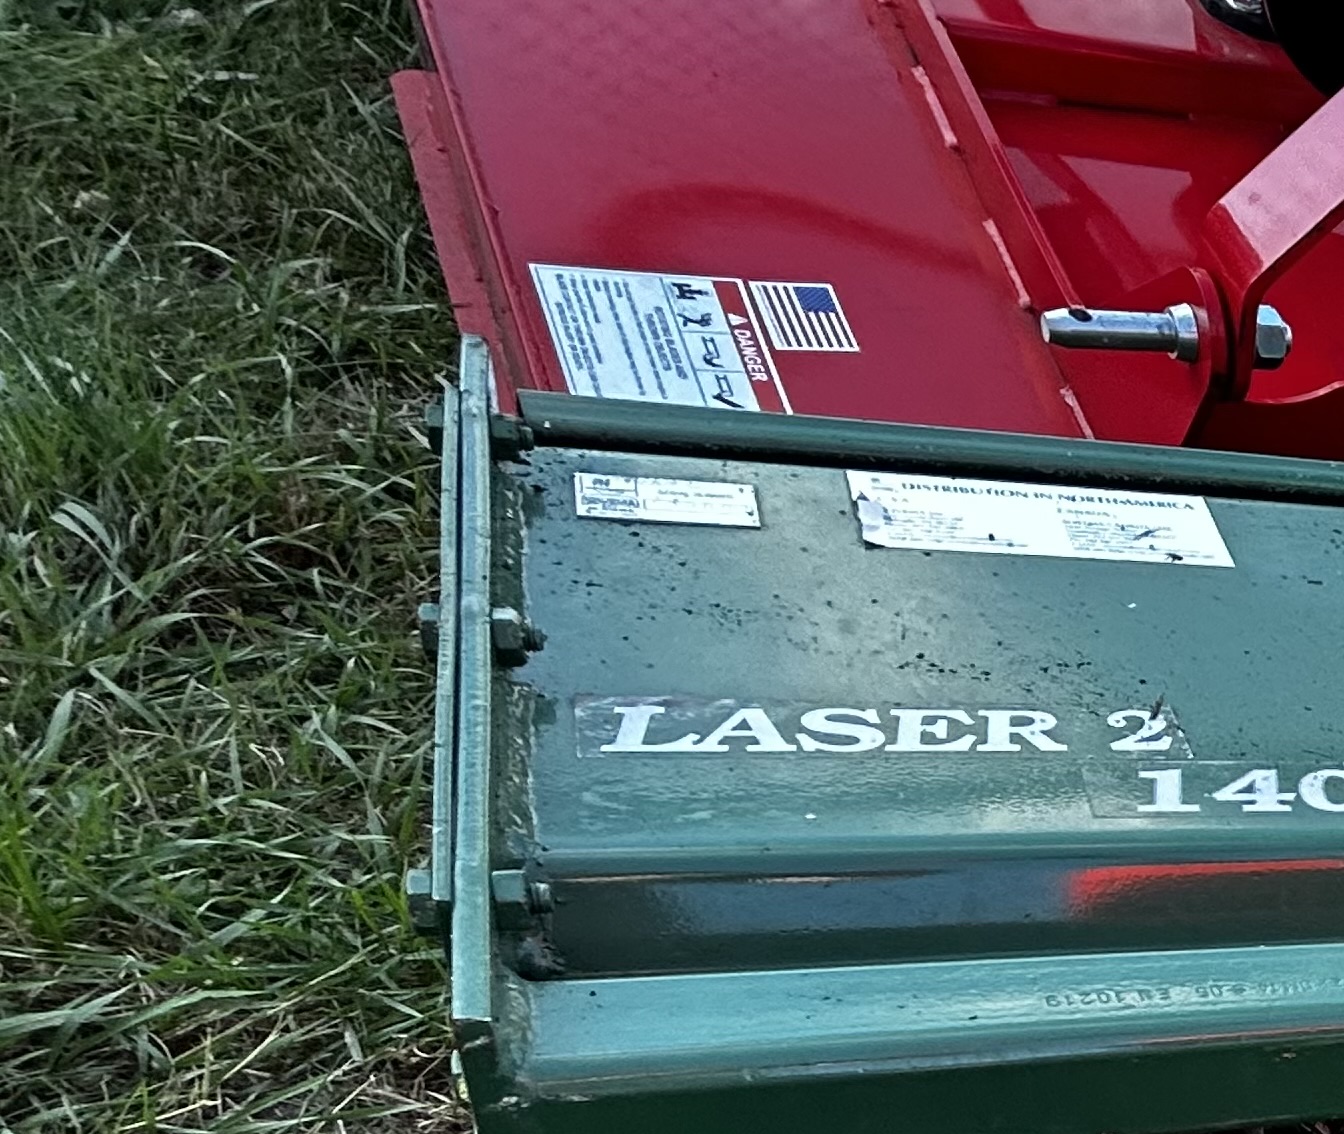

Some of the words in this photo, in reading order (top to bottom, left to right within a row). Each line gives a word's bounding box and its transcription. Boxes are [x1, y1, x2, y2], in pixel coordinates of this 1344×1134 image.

[733, 329, 769, 381] DANGER
[901, 482, 1029, 498] DISTRIBUTION
[1033, 492, 1053, 500] IN
[600, 705, 1067, 753] LASER
[1107, 708, 1173, 753] 2
